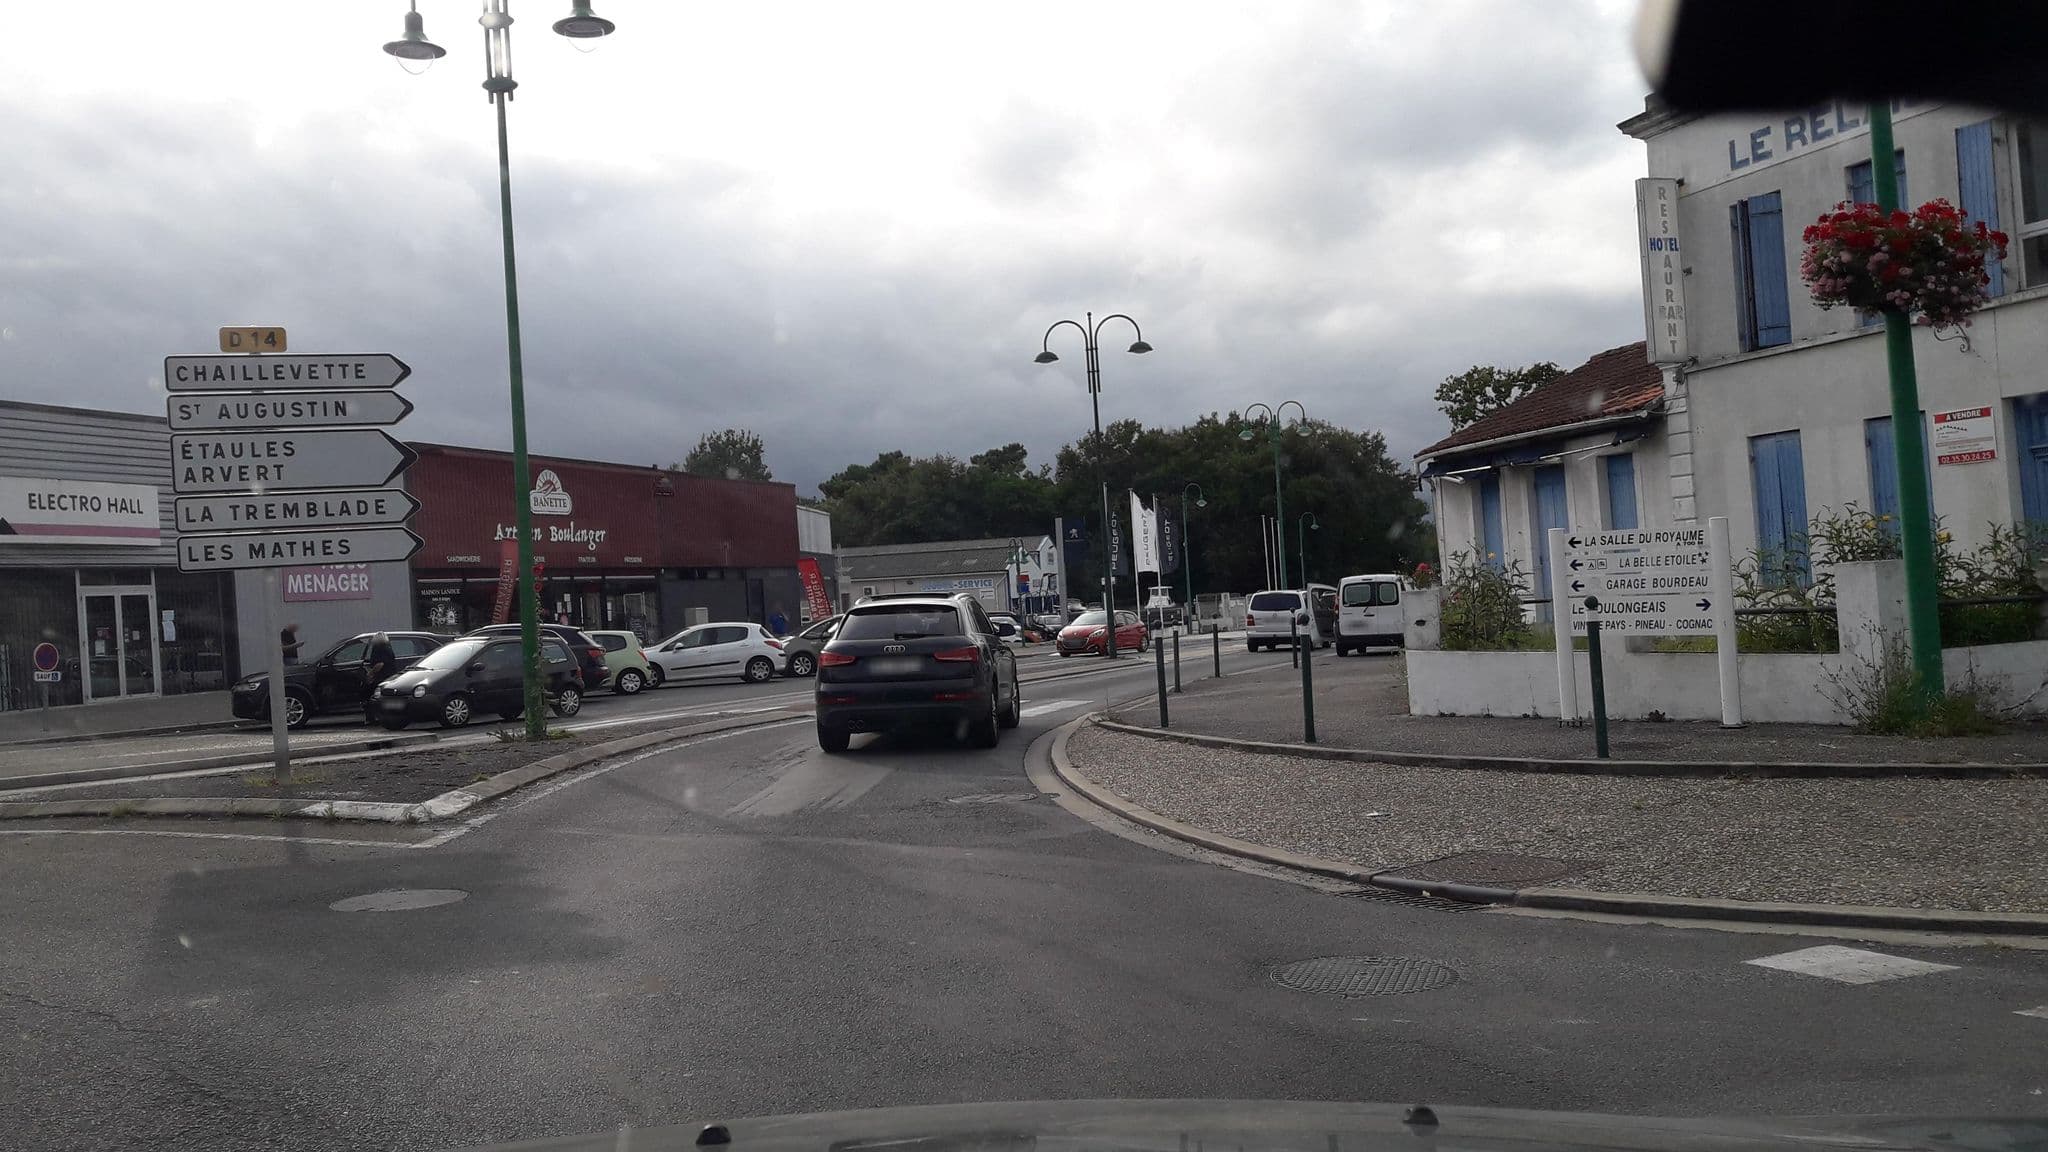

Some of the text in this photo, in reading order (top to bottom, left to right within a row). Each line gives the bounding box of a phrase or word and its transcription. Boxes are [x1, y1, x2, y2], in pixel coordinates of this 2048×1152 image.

[1728, 125, 1774, 171] LE
[1649, 237, 1679, 251] HOTEL
[1658, 186, 1678, 354] RESTAURANT
[229, 331, 278, 347] D 14
[176, 363, 367, 382] CHAILLEVETTE
[217, 400, 348, 420] AUGUSTIN
[1952, 410, 1981, 420] VENDRE
[182, 440, 296, 460] ÉTAULES
[184, 464, 285, 483] ARVERT
[27, 492, 144, 515] ELECTRO HALL
[185, 499, 387, 523] LA TREMBLADE
[533, 497, 568, 508] BANETTE
[494, 521, 606, 551] Artn Boulanger
[1585, 530, 1704, 547] LA SALLE DU ROYAUME
[188, 539, 351, 562] LES MATHES
[1619, 554, 1697, 568] LA BELLE ETOILE
[288, 573, 369, 594] MENAGER
[1606, 576, 1708, 590] GARAGE BOURDEAU
[1597, 601, 1666, 614] OULONGEAIS
[1605, 620, 1626, 630] PAYS
[1635, 619, 1666, 630] PINEAU
[1676, 618, 1713, 629] COGNAC
